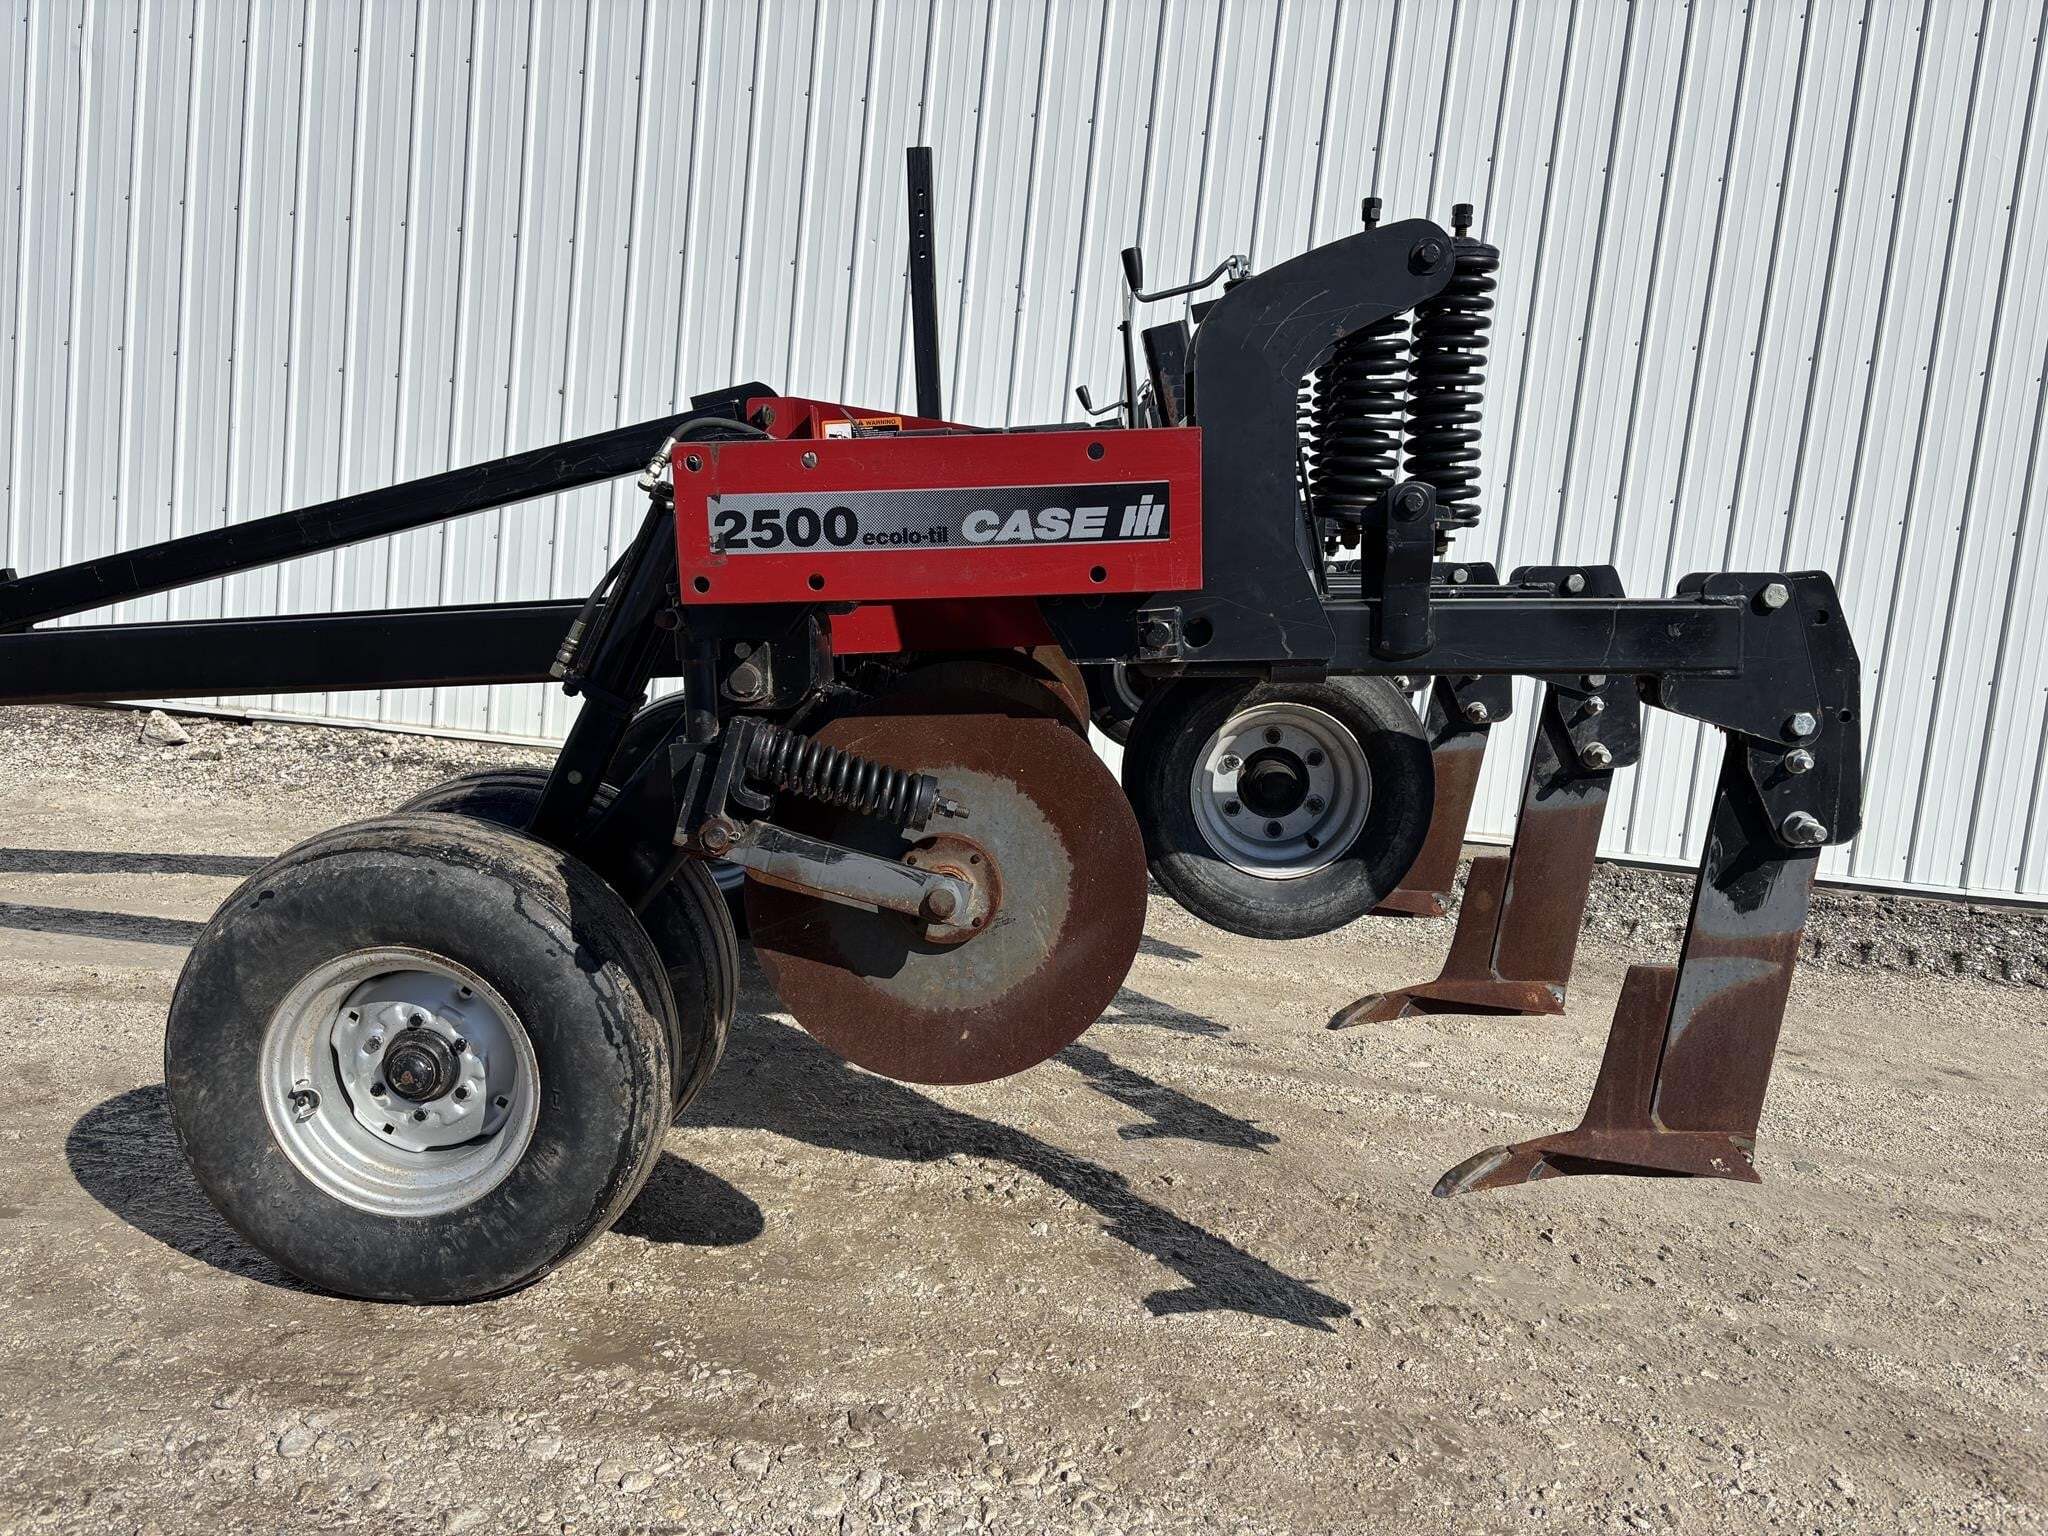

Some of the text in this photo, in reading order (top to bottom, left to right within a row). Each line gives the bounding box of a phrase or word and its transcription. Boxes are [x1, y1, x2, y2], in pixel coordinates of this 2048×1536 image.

[714, 506, 949, 548] 2500 ecolo-til
[962, 507, 1109, 543] CASE
